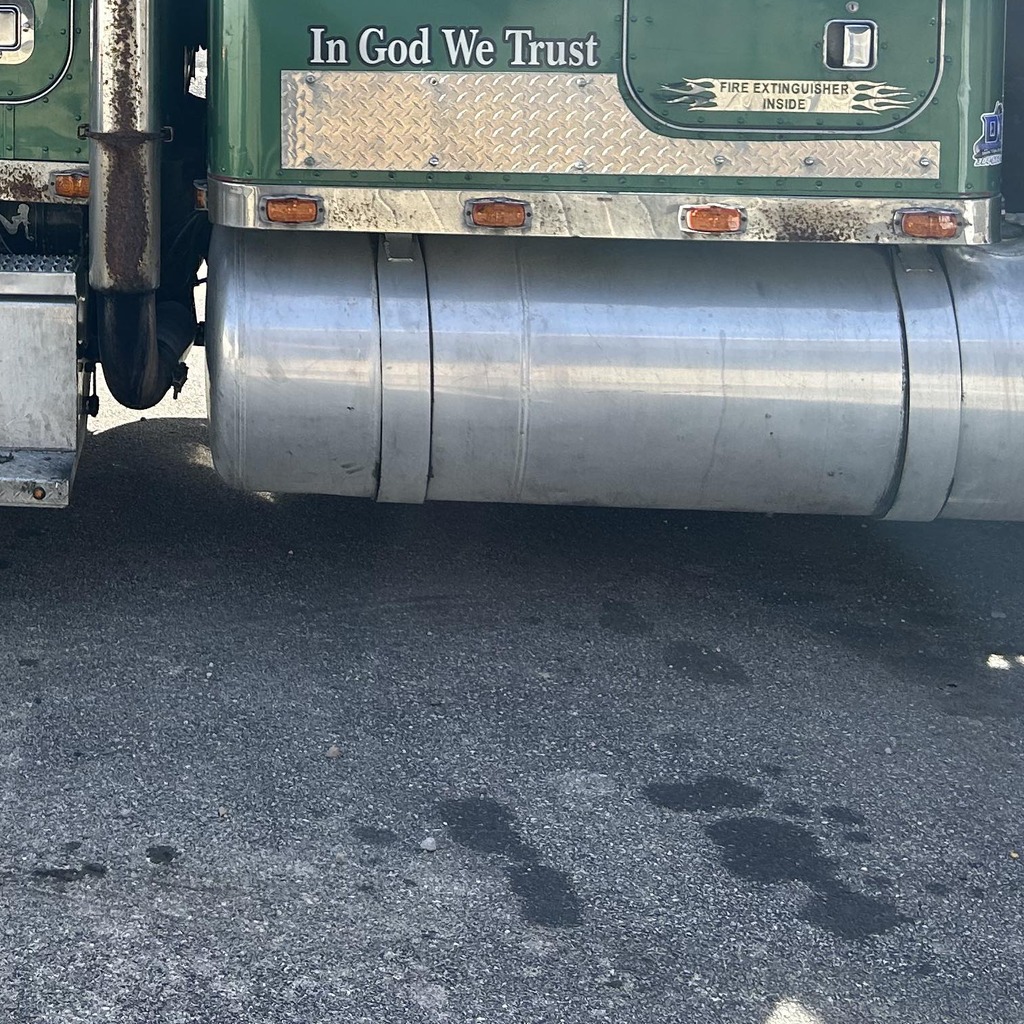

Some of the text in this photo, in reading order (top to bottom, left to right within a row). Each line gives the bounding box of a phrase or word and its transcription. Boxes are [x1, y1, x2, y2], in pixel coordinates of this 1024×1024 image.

[310, 27, 598, 66] In God We Trust
[720, 81, 849, 95] FIRE EXTINGUISHER
[763, 98, 806, 110] INSIDE
